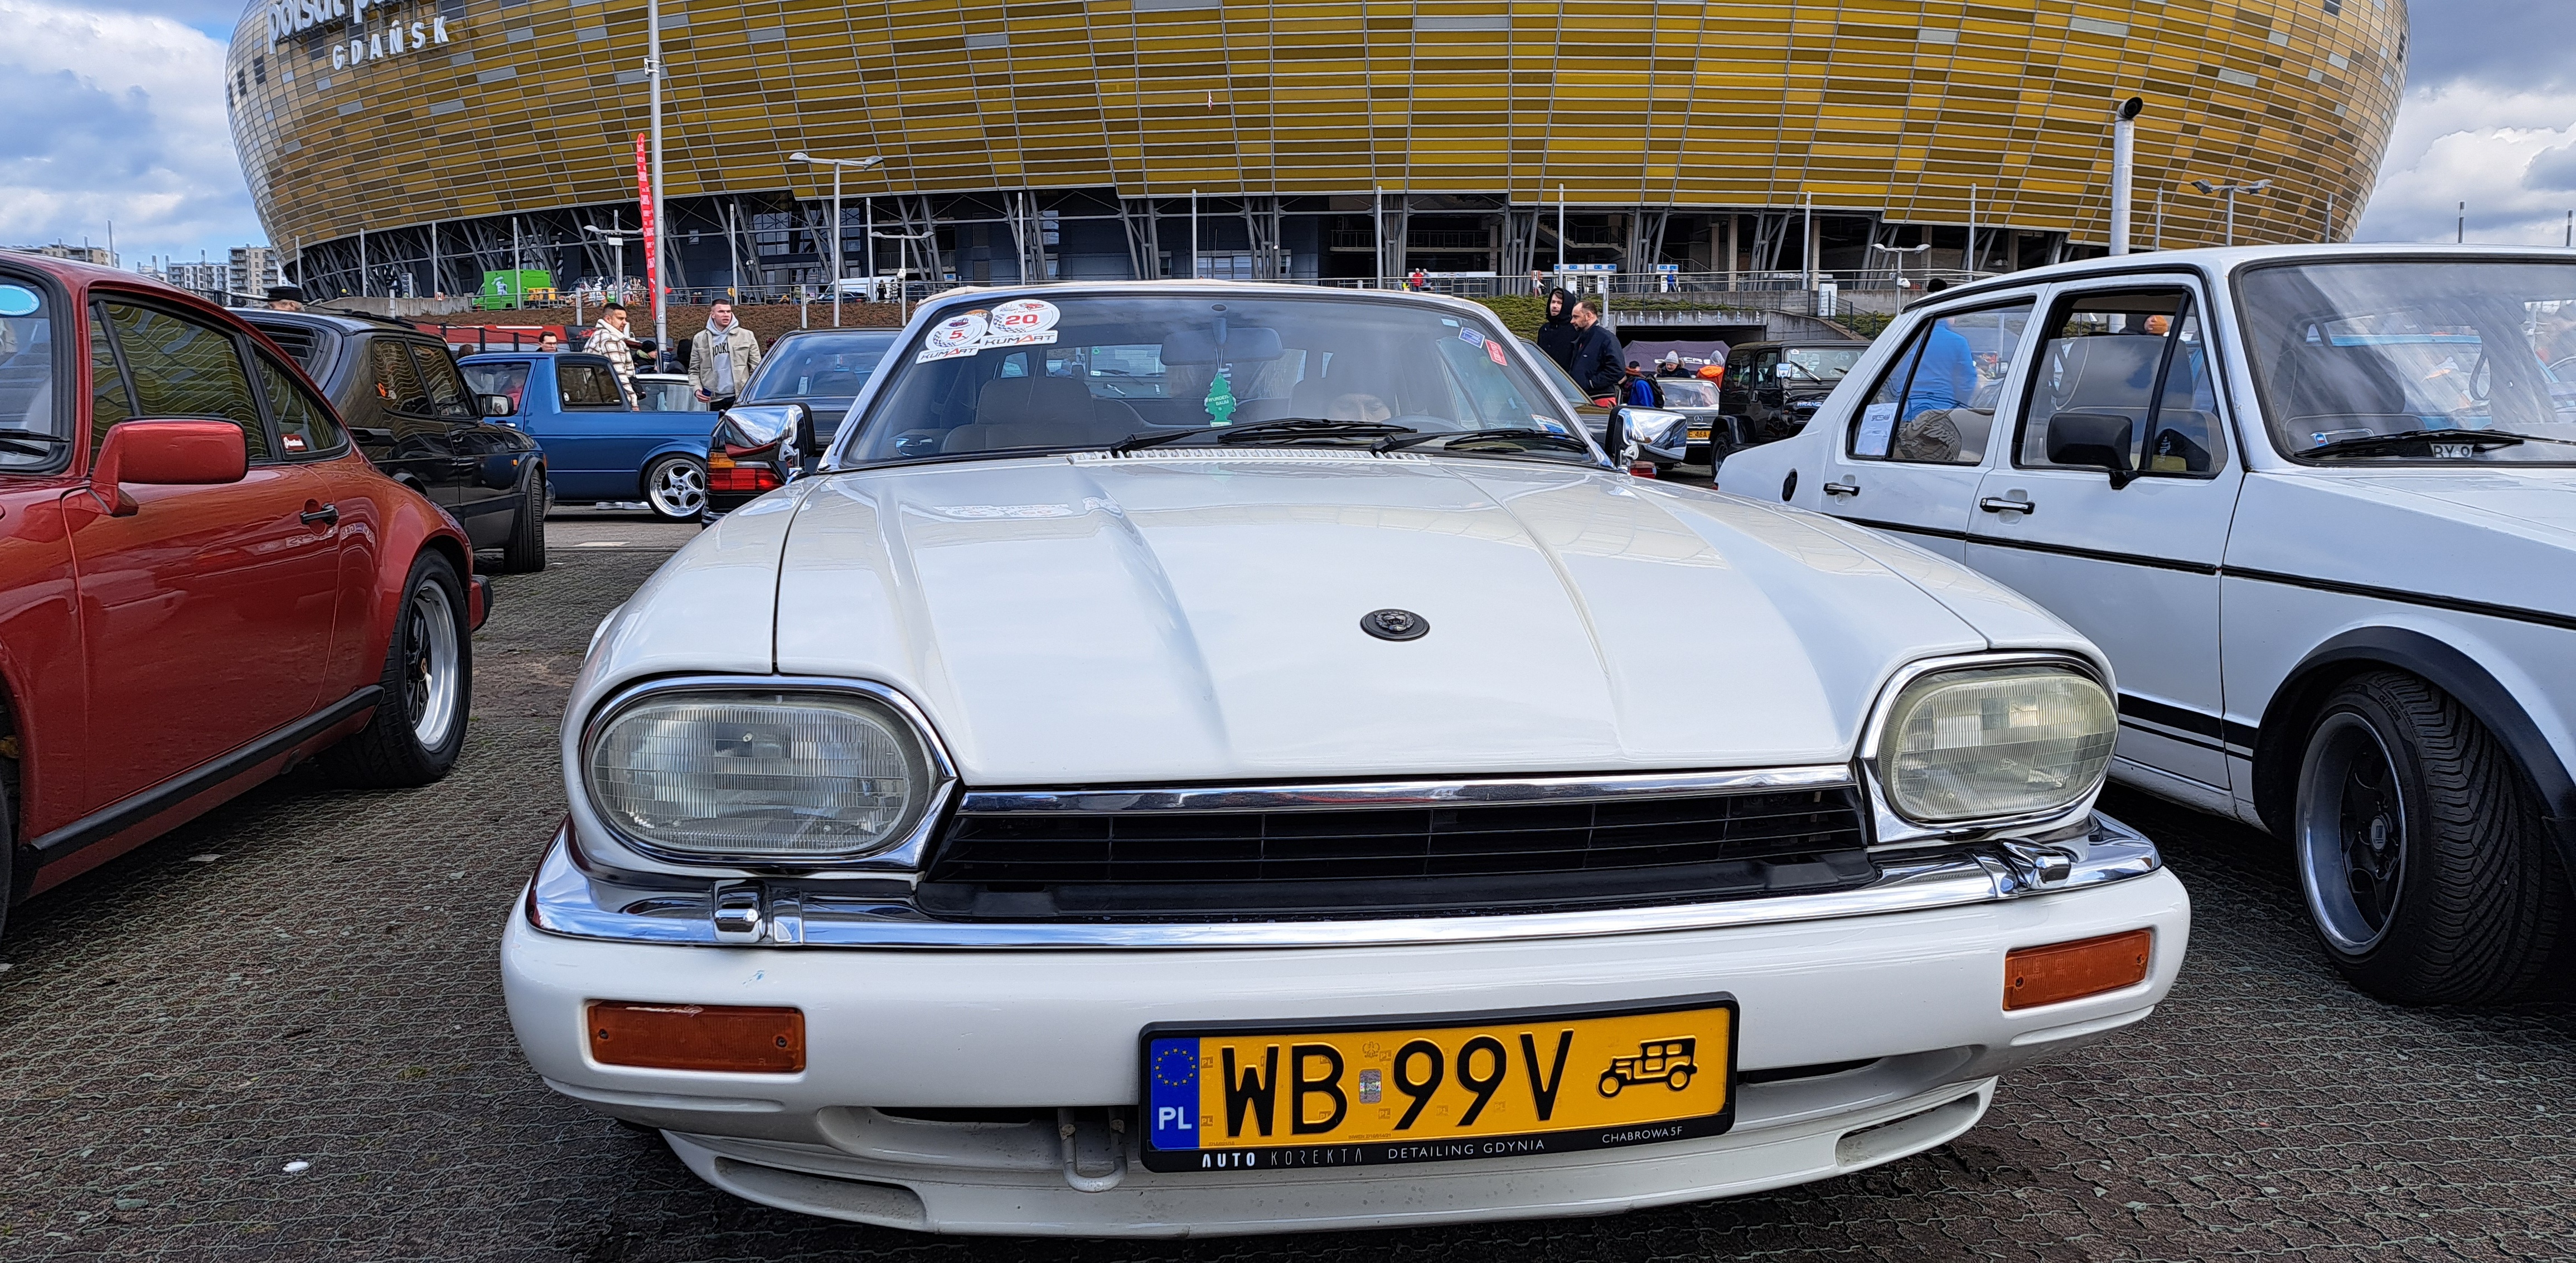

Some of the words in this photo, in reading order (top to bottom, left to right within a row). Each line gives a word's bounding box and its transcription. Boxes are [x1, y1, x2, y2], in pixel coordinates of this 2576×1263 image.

[333, 16, 449, 70] GDAŃSK
[985, 335, 1055, 346] KUMART
[921, 347, 977, 360] KUMART
[1221, 1043, 1348, 1137] WB
[1392, 1029, 1574, 1130] 99V
[1159, 1106, 1192, 1130] PL
[1602, 1128, 1668, 1144] CHABROWA
[1202, 1152, 1255, 1168] AUTO
[1388, 1144, 1474, 1159] DETAILING
[1484, 1139, 1544, 1154] GDYNIA
